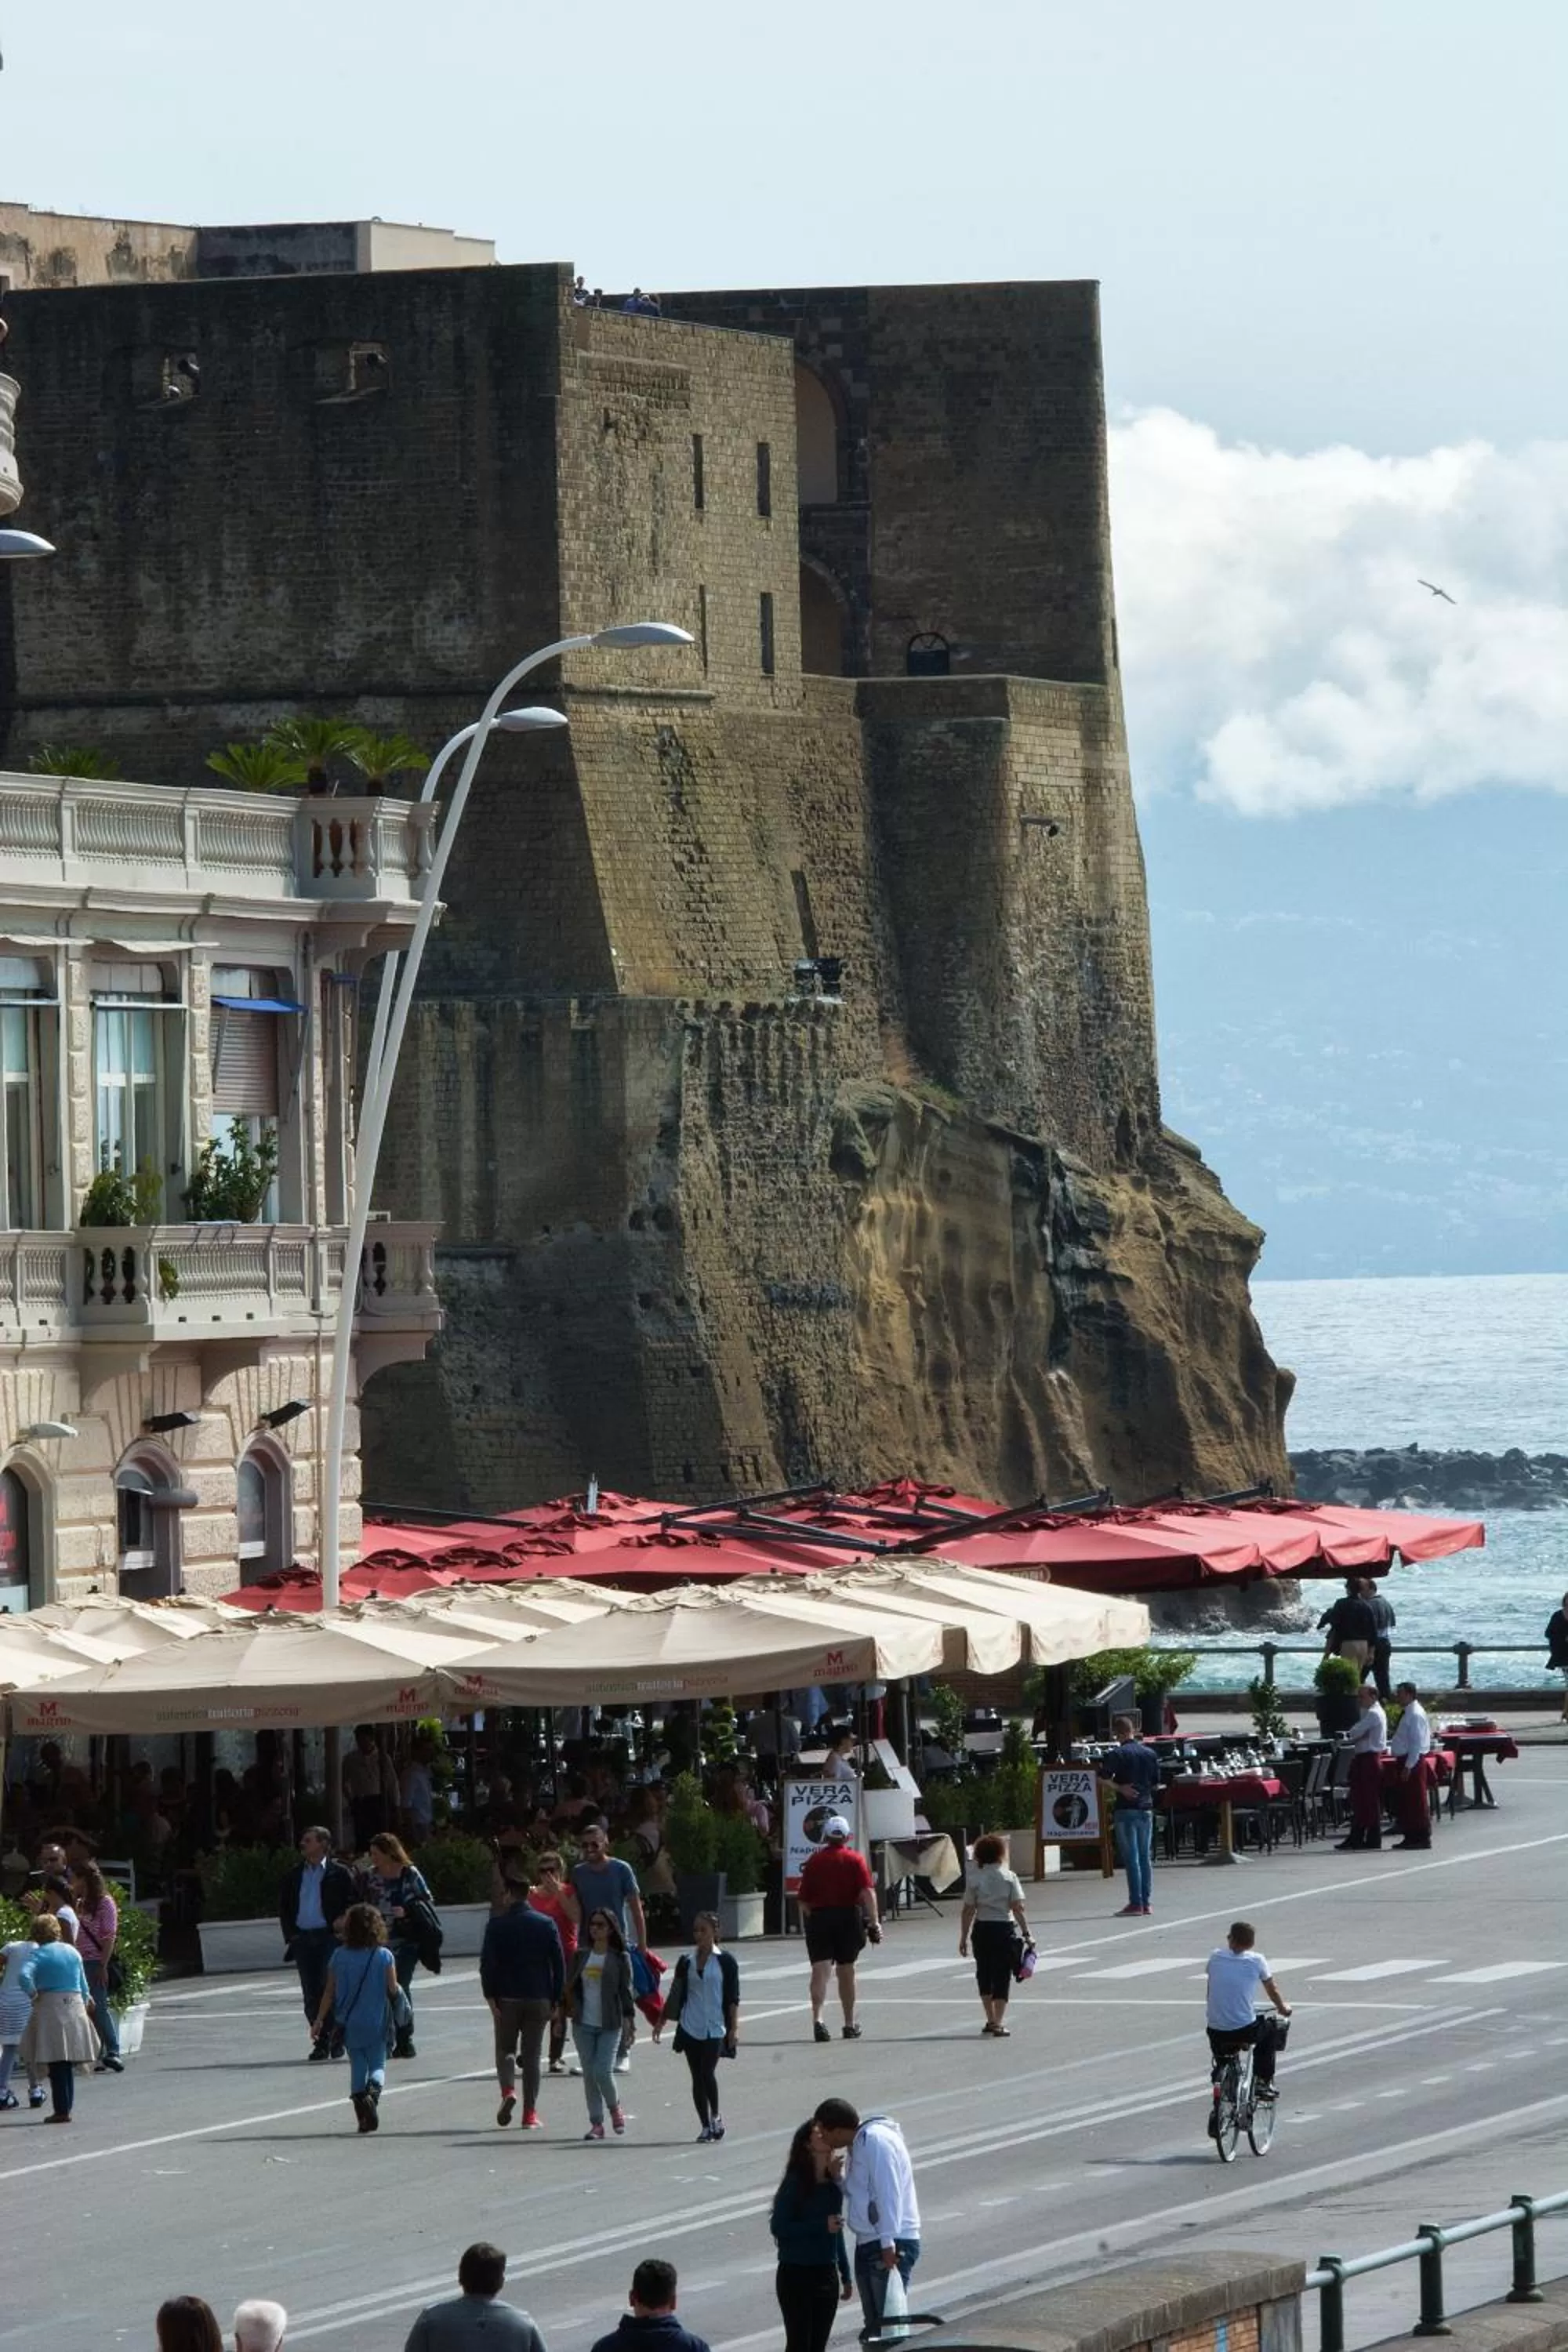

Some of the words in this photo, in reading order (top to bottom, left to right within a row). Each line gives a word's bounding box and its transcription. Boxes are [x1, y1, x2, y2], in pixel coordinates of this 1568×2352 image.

[1049, 1773, 1091, 1783] VERA
[795, 1784, 852, 1795] VERA
[1047, 1782, 1092, 1792] PIZZA
[791, 1795, 854, 1806] PIZZA
